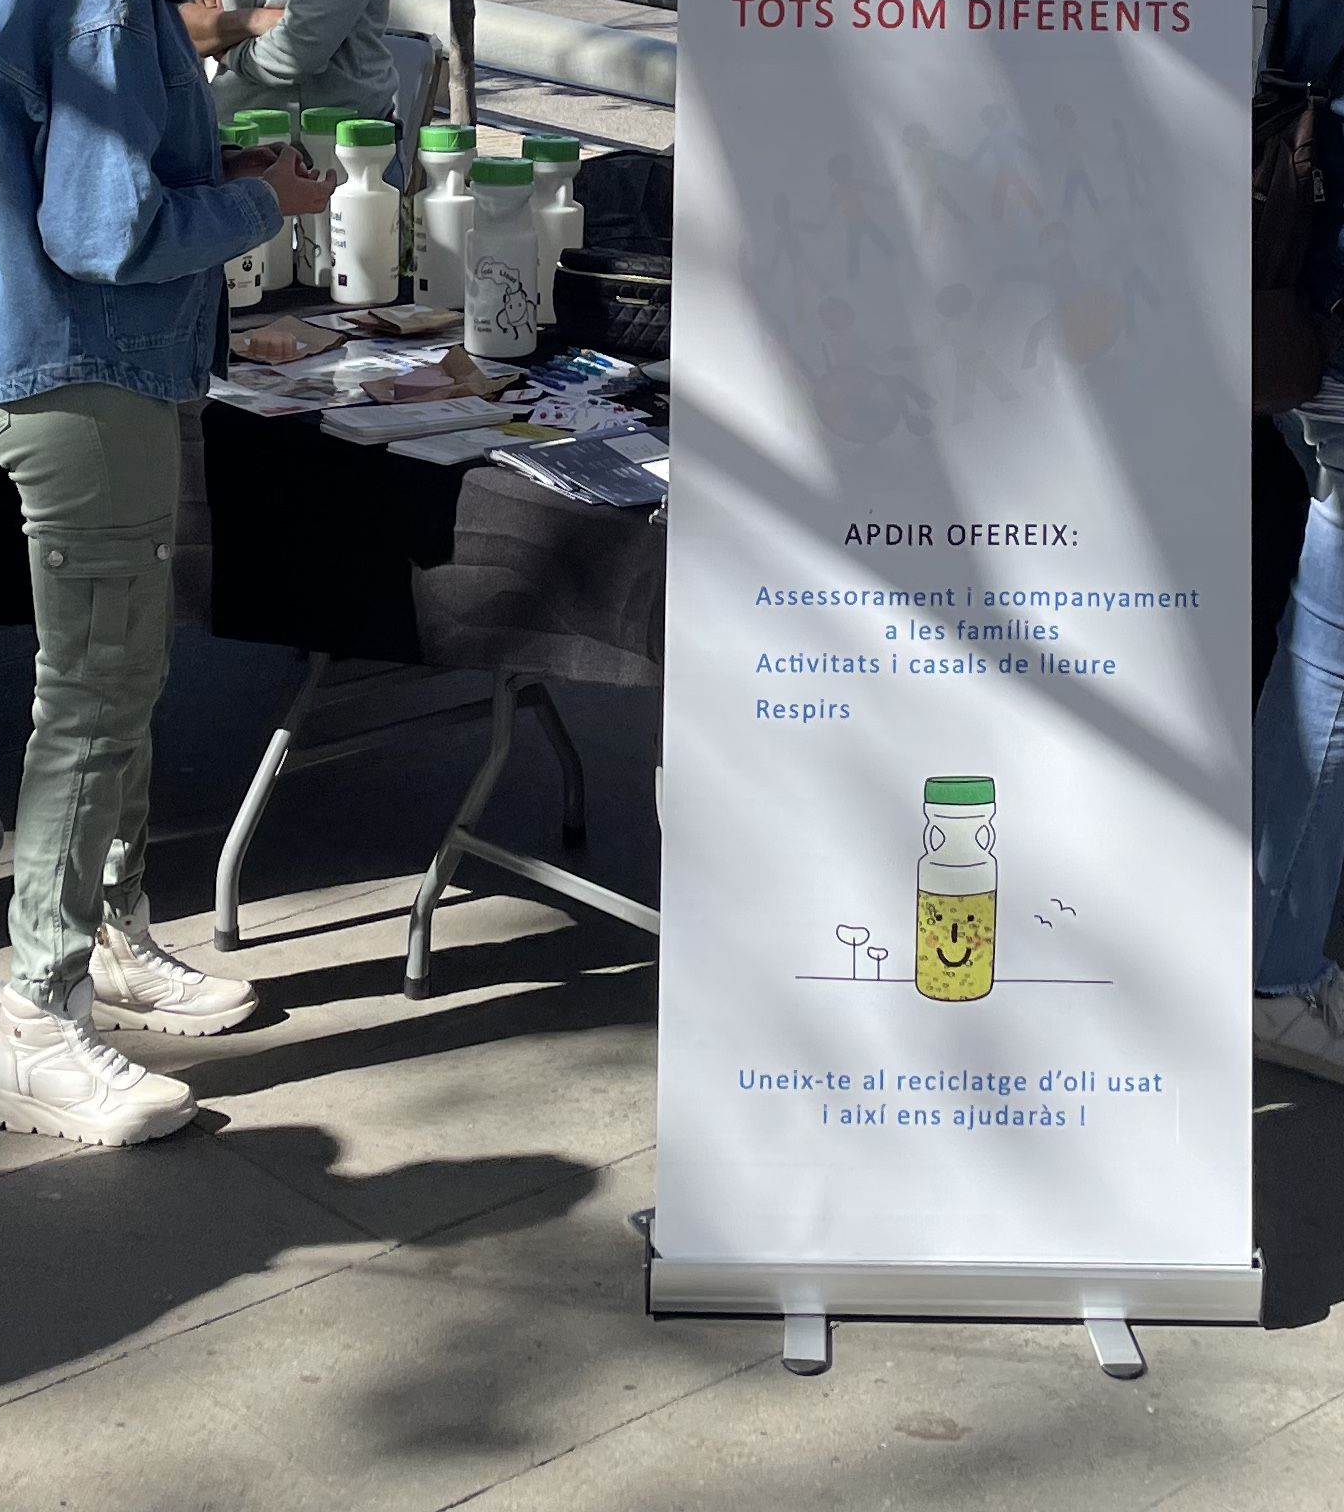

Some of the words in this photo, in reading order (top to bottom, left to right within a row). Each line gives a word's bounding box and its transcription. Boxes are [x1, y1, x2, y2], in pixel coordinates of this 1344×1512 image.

[844, 522, 934, 547] APDIR
[946, 523, 1079, 547] OFEREIX:
[755, 586, 956, 608] Assessorament
[967, 586, 972, 607] i
[983, 588, 1200, 613] acompanyament
[885, 624, 897, 641] a
[910, 619, 945, 641] les
[956, 619, 1059, 641] famílies
[756, 652, 881, 674] Activitats
[892, 653, 897, 674] i
[909, 653, 987, 675] casals
[998, 653, 1028, 675] de
[1040, 653, 1116, 675] lleure
[756, 699, 850, 724] Respirs
[739, 1069, 851, 1091] Uneix-te
[863, 1069, 884, 1091] al
[897, 1070, 1027, 1096] reciclatge
[1108, 1072, 1163, 1093] usat
[823, 1104, 828, 1126] i
[839, 1104, 887, 1126] així
[897, 1109, 941, 1126] ens
[953, 1104, 1066, 1130] ajudaràs
[1080, 1104, 1086, 1127] !
